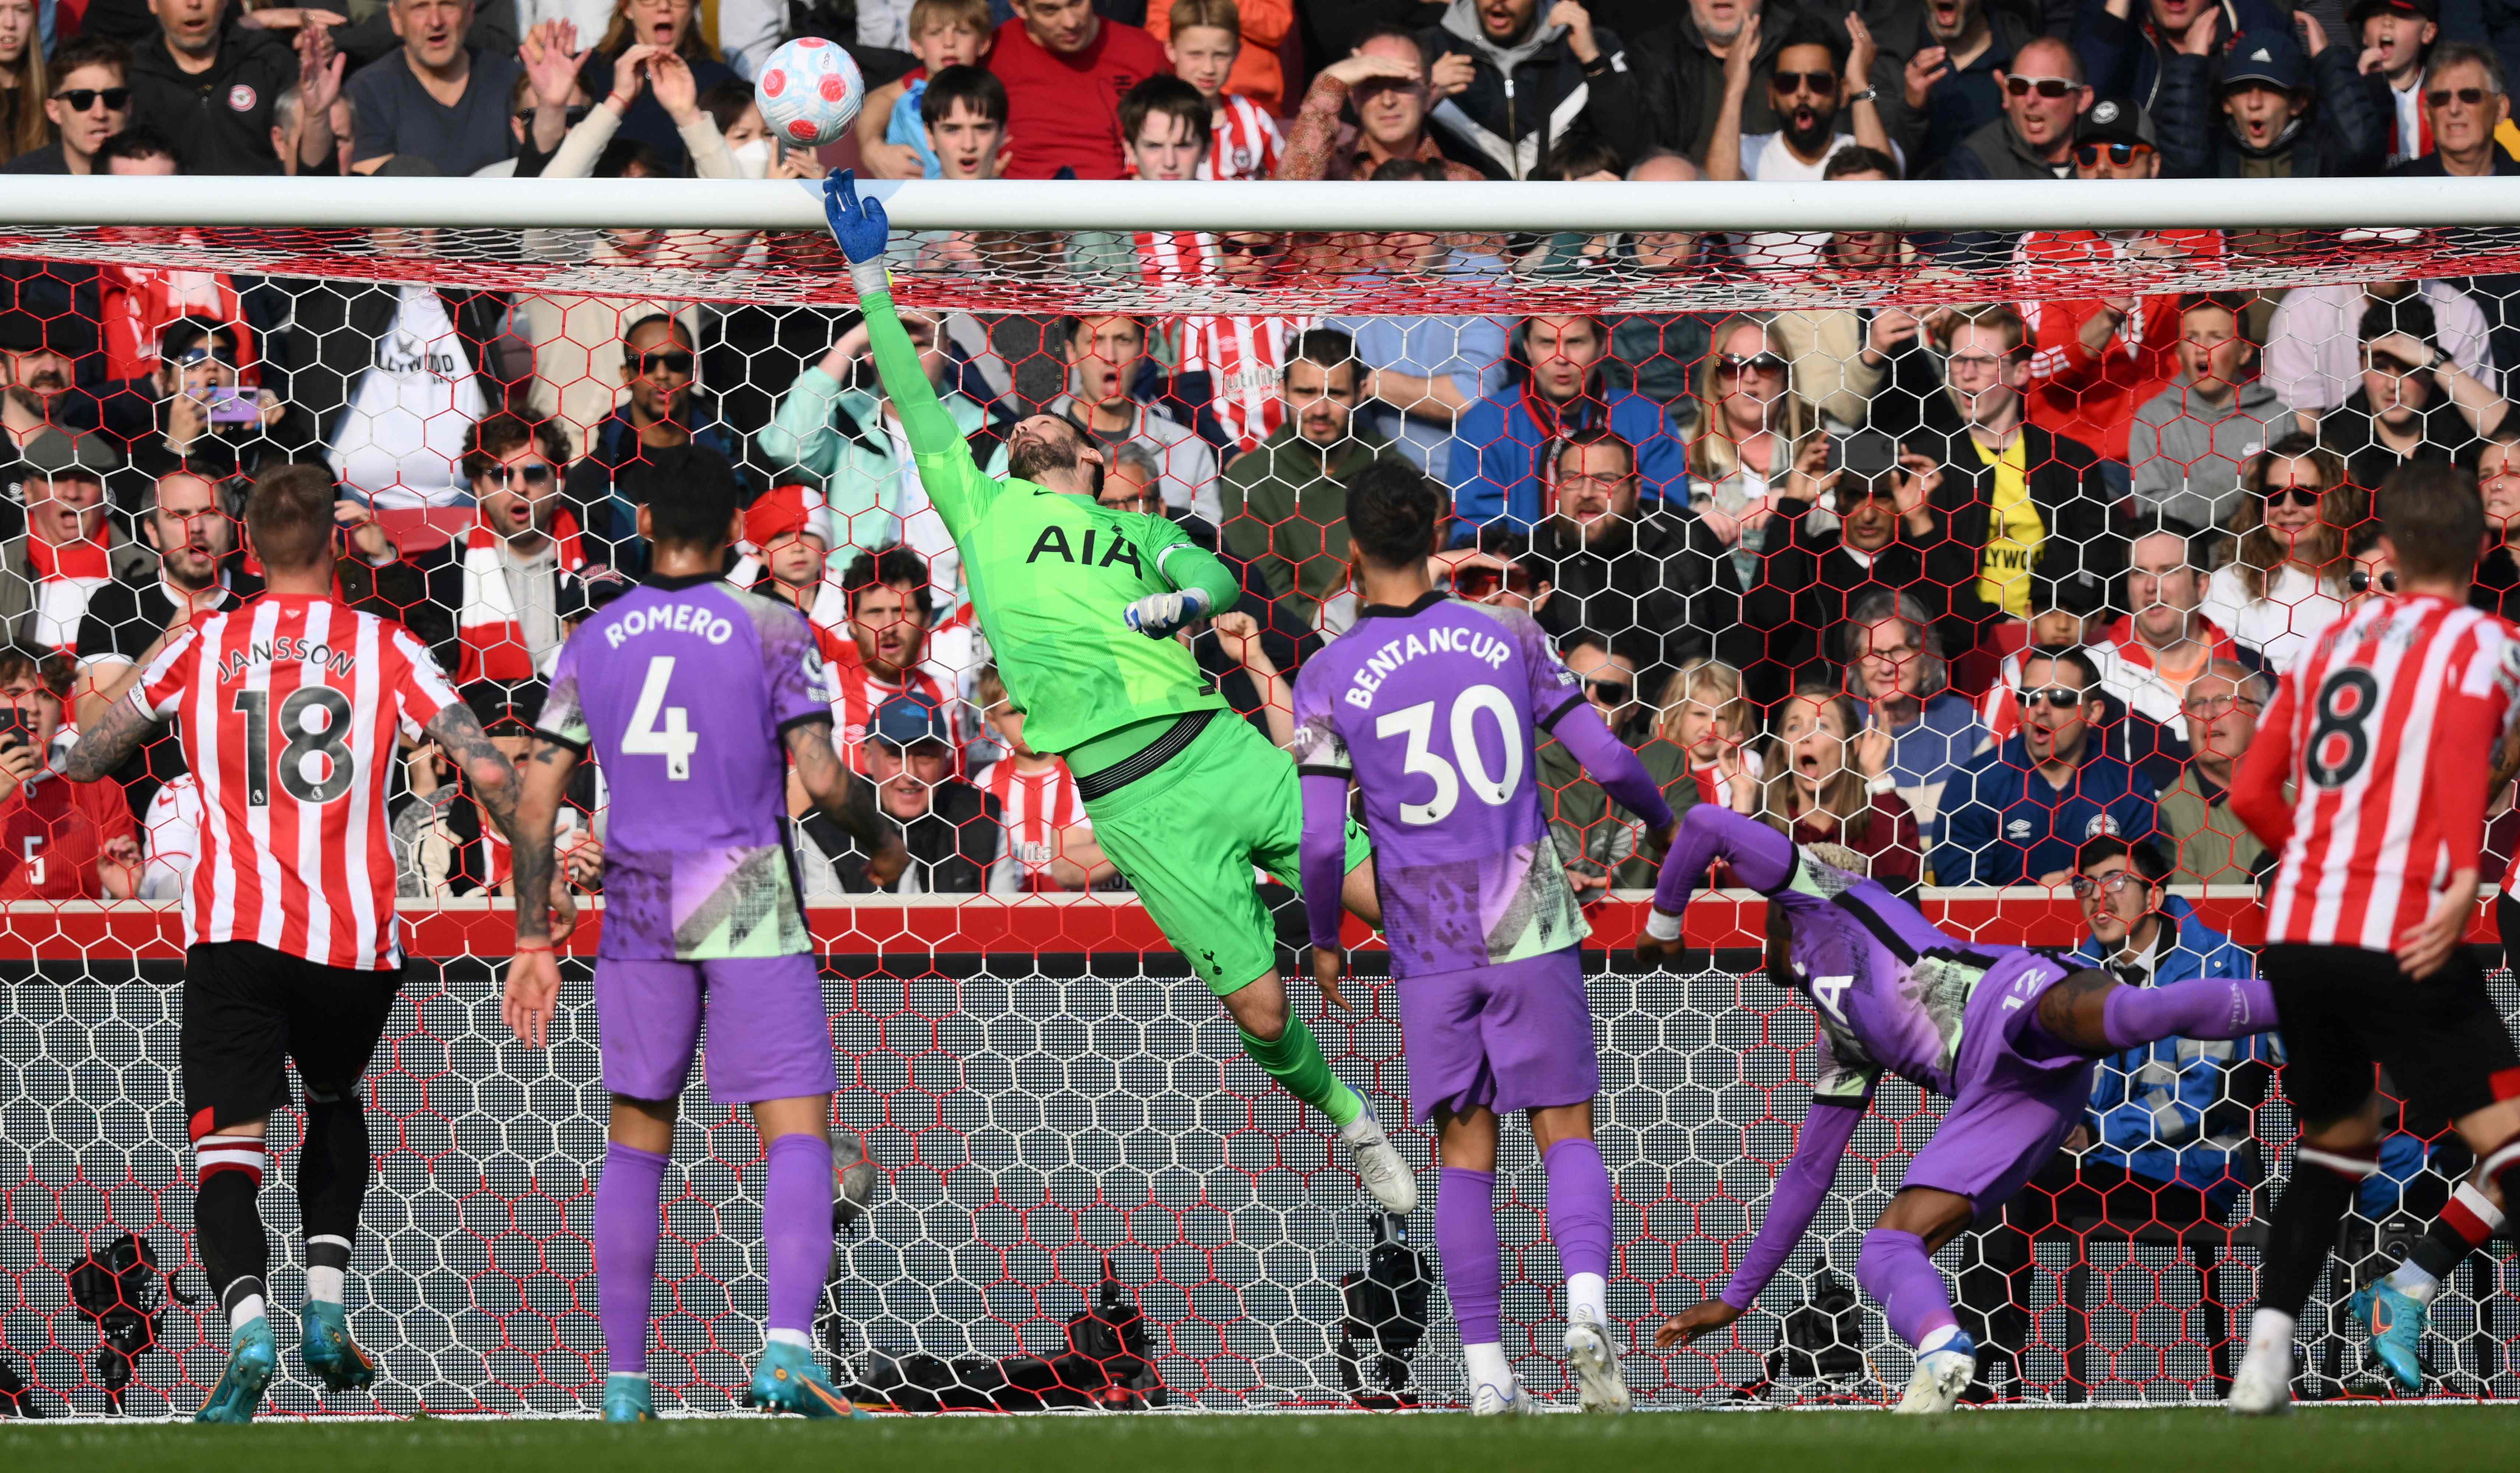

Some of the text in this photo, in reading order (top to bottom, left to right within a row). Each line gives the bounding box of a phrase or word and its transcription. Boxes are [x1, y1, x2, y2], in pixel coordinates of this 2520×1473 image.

[1026, 525, 1142, 581] AIA
[218, 636, 356, 684] JANSSON
[604, 603, 733, 650] ROMERO
[1344, 627, 1511, 710] BENTANCUR
[232, 685, 355, 807] 18
[621, 655, 699, 781] 4
[2305, 666, 2377, 788] 8
[1375, 684, 1523, 826] 30
[24, 836, 45, 885] 5
[2002, 968, 2047, 1010] 12
